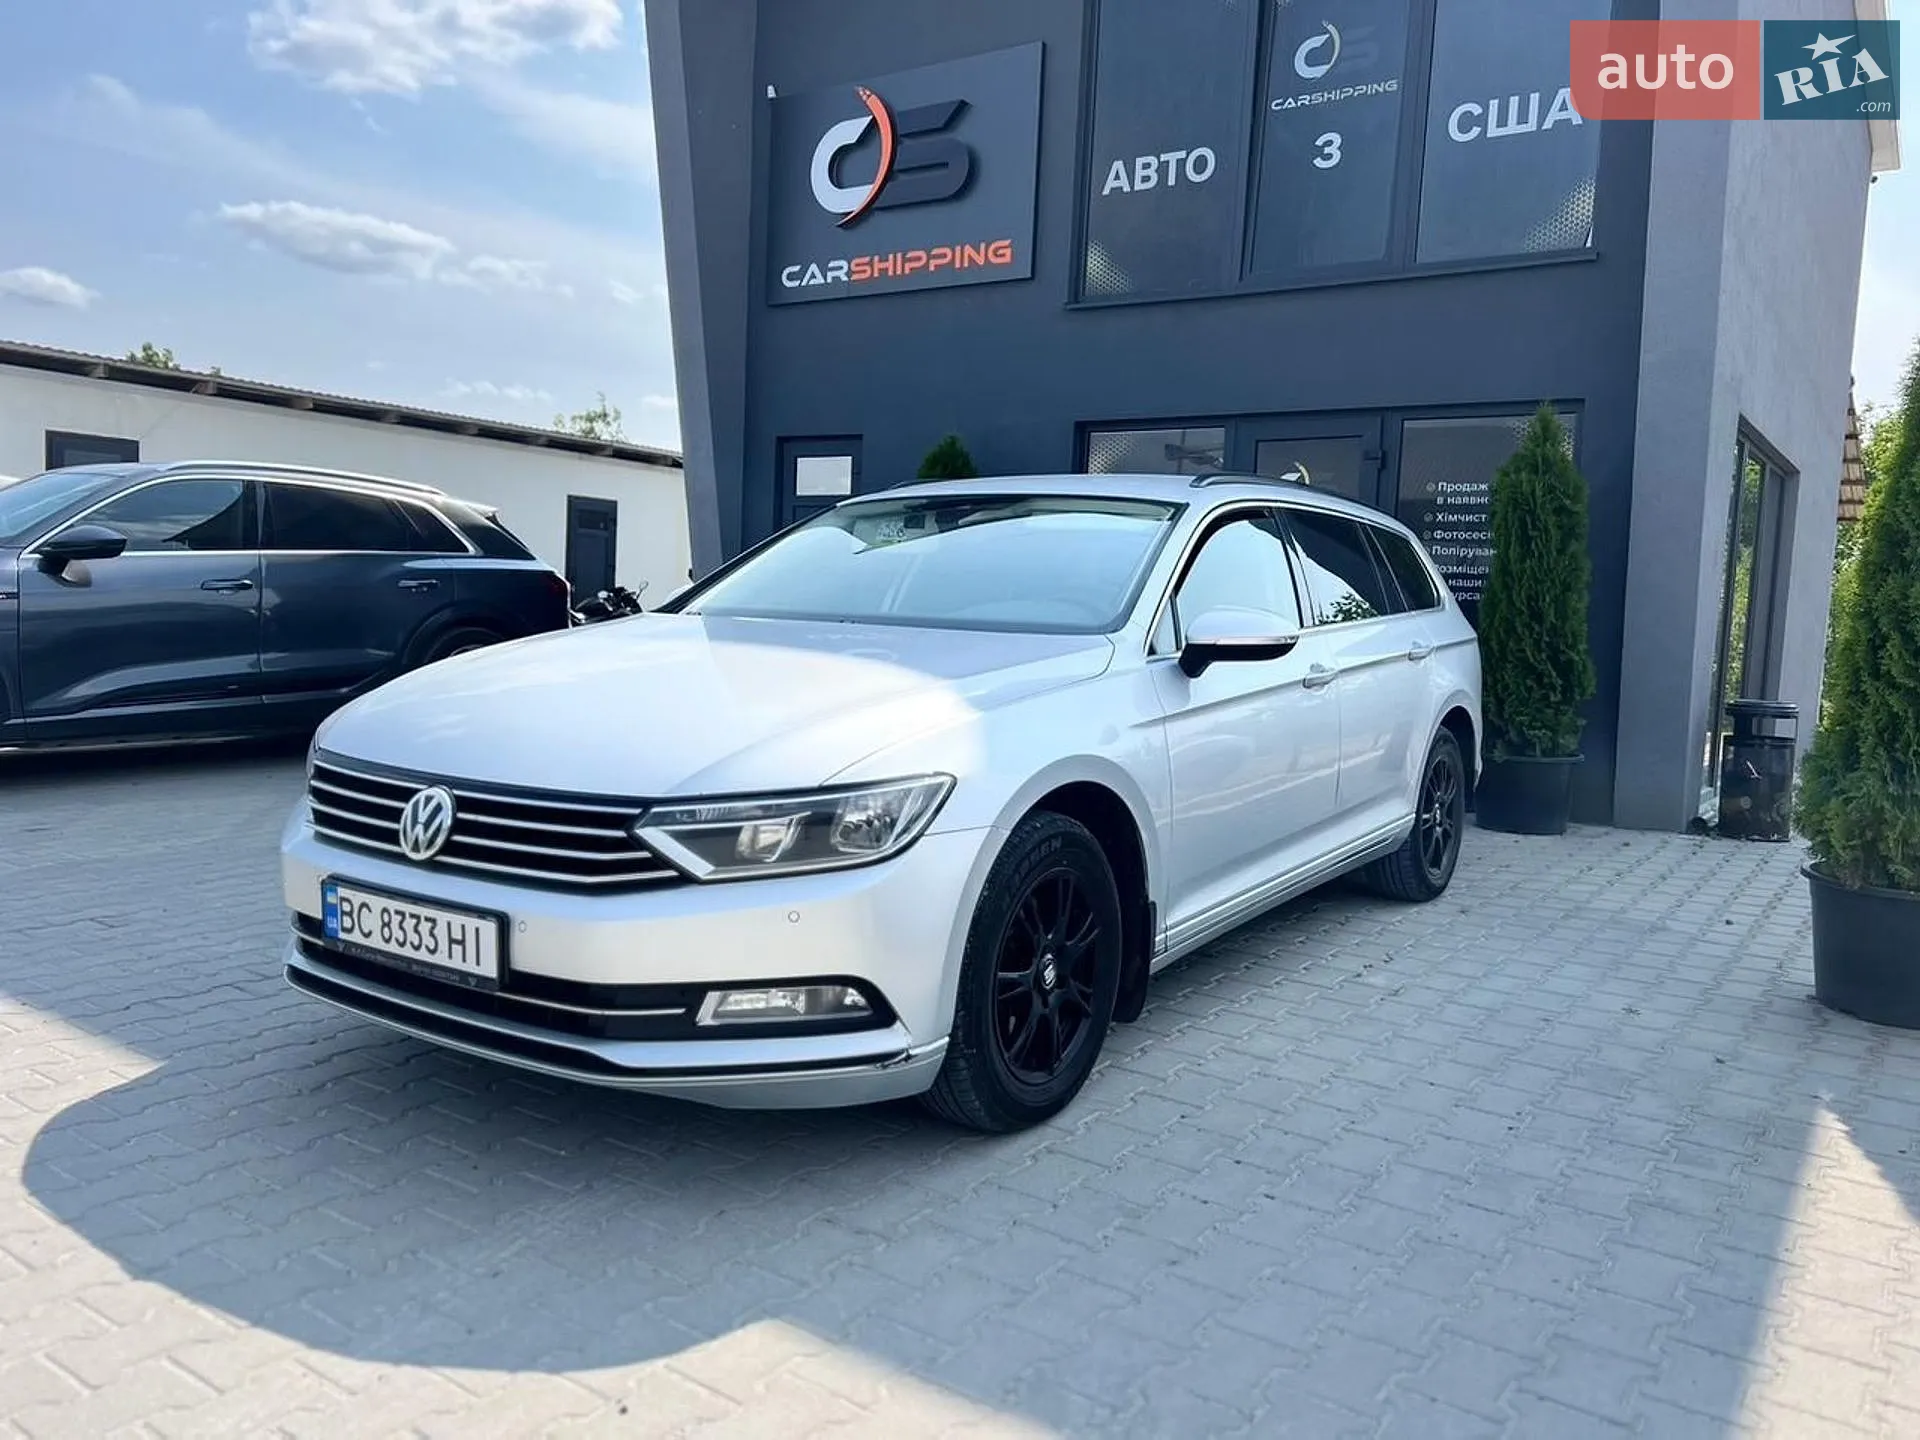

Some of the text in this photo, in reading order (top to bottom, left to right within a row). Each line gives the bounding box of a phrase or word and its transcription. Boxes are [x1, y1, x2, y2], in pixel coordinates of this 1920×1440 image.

[1270, 78, 1400, 111] CARSHIPPING
[1101, 146, 1216, 196] АВТО
[1447, 86, 1584, 143] США
[781, 238, 1013, 289] CARSHIPPING
[1437, 481, 1489, 493] Продаж
[1435, 511, 1489, 523] Хімчист
[1433, 530, 1492, 540] Фотосесі
[1431, 546, 1498, 558] Поліруван
[1437, 564, 1489, 575] озміще
[1448, 578, 1486, 588] наши
[339, 896, 373, 939] BC
[380, 908, 438, 956] 8333
[446, 921, 481, 967] HI
